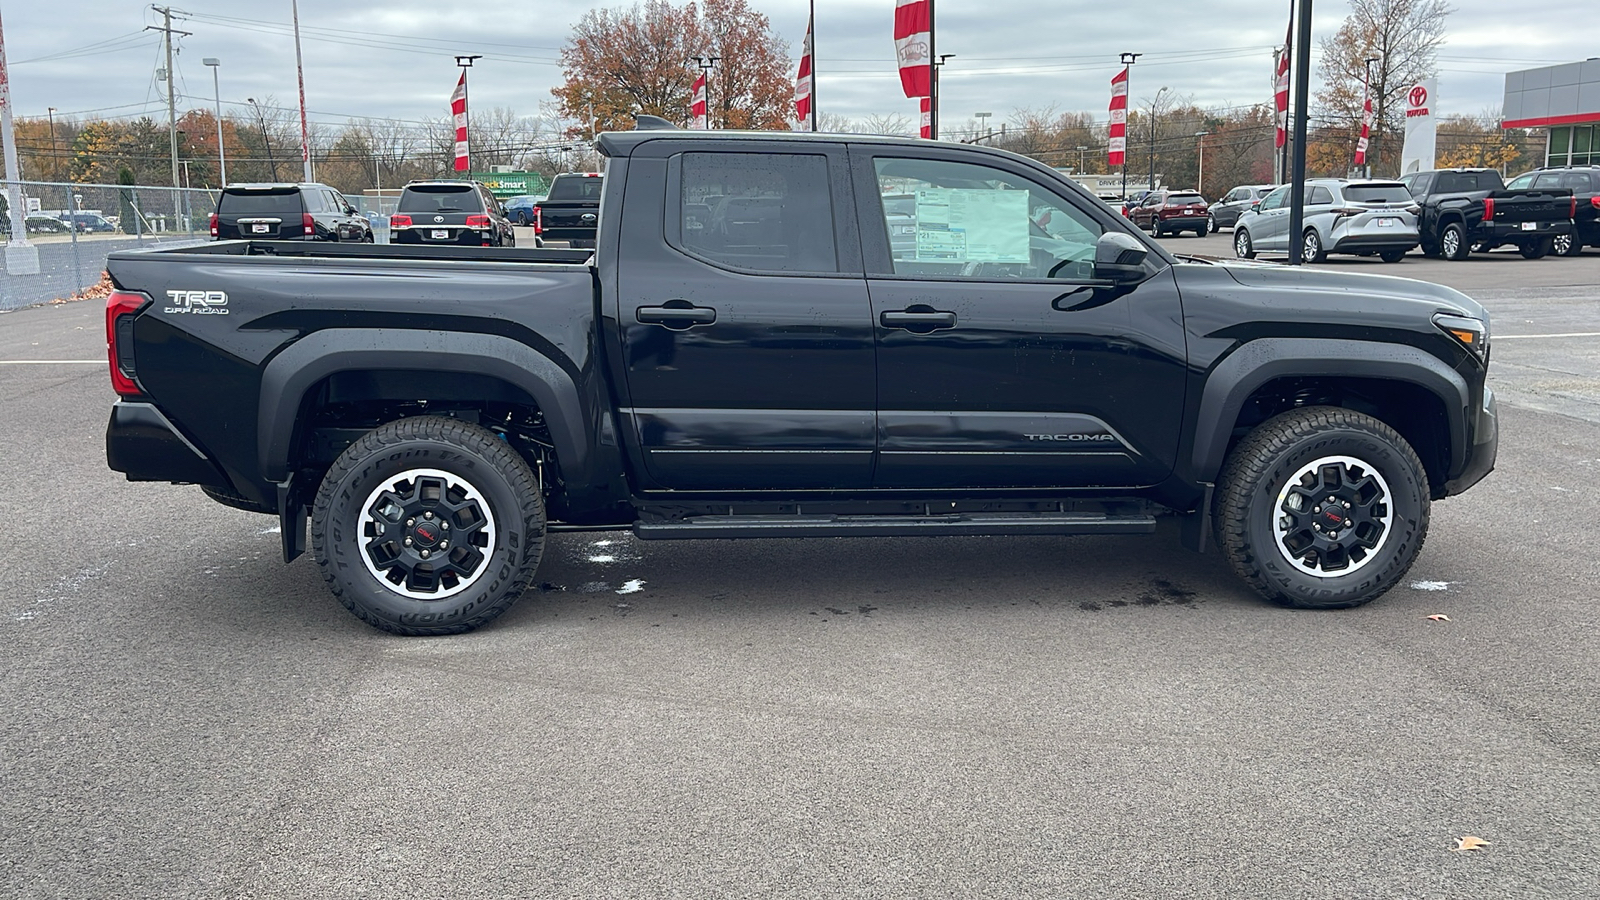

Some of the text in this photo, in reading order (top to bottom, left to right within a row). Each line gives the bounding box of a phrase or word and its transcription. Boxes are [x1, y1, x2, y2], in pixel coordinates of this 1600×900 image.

[1406, 108, 1429, 117] TOYOTA
[166, 290, 229, 307] TRD
[164, 306, 230, 315] OFF ROAD
[1023, 433, 1115, 441] TACOMA
[1325, 511, 1342, 523] TRD
